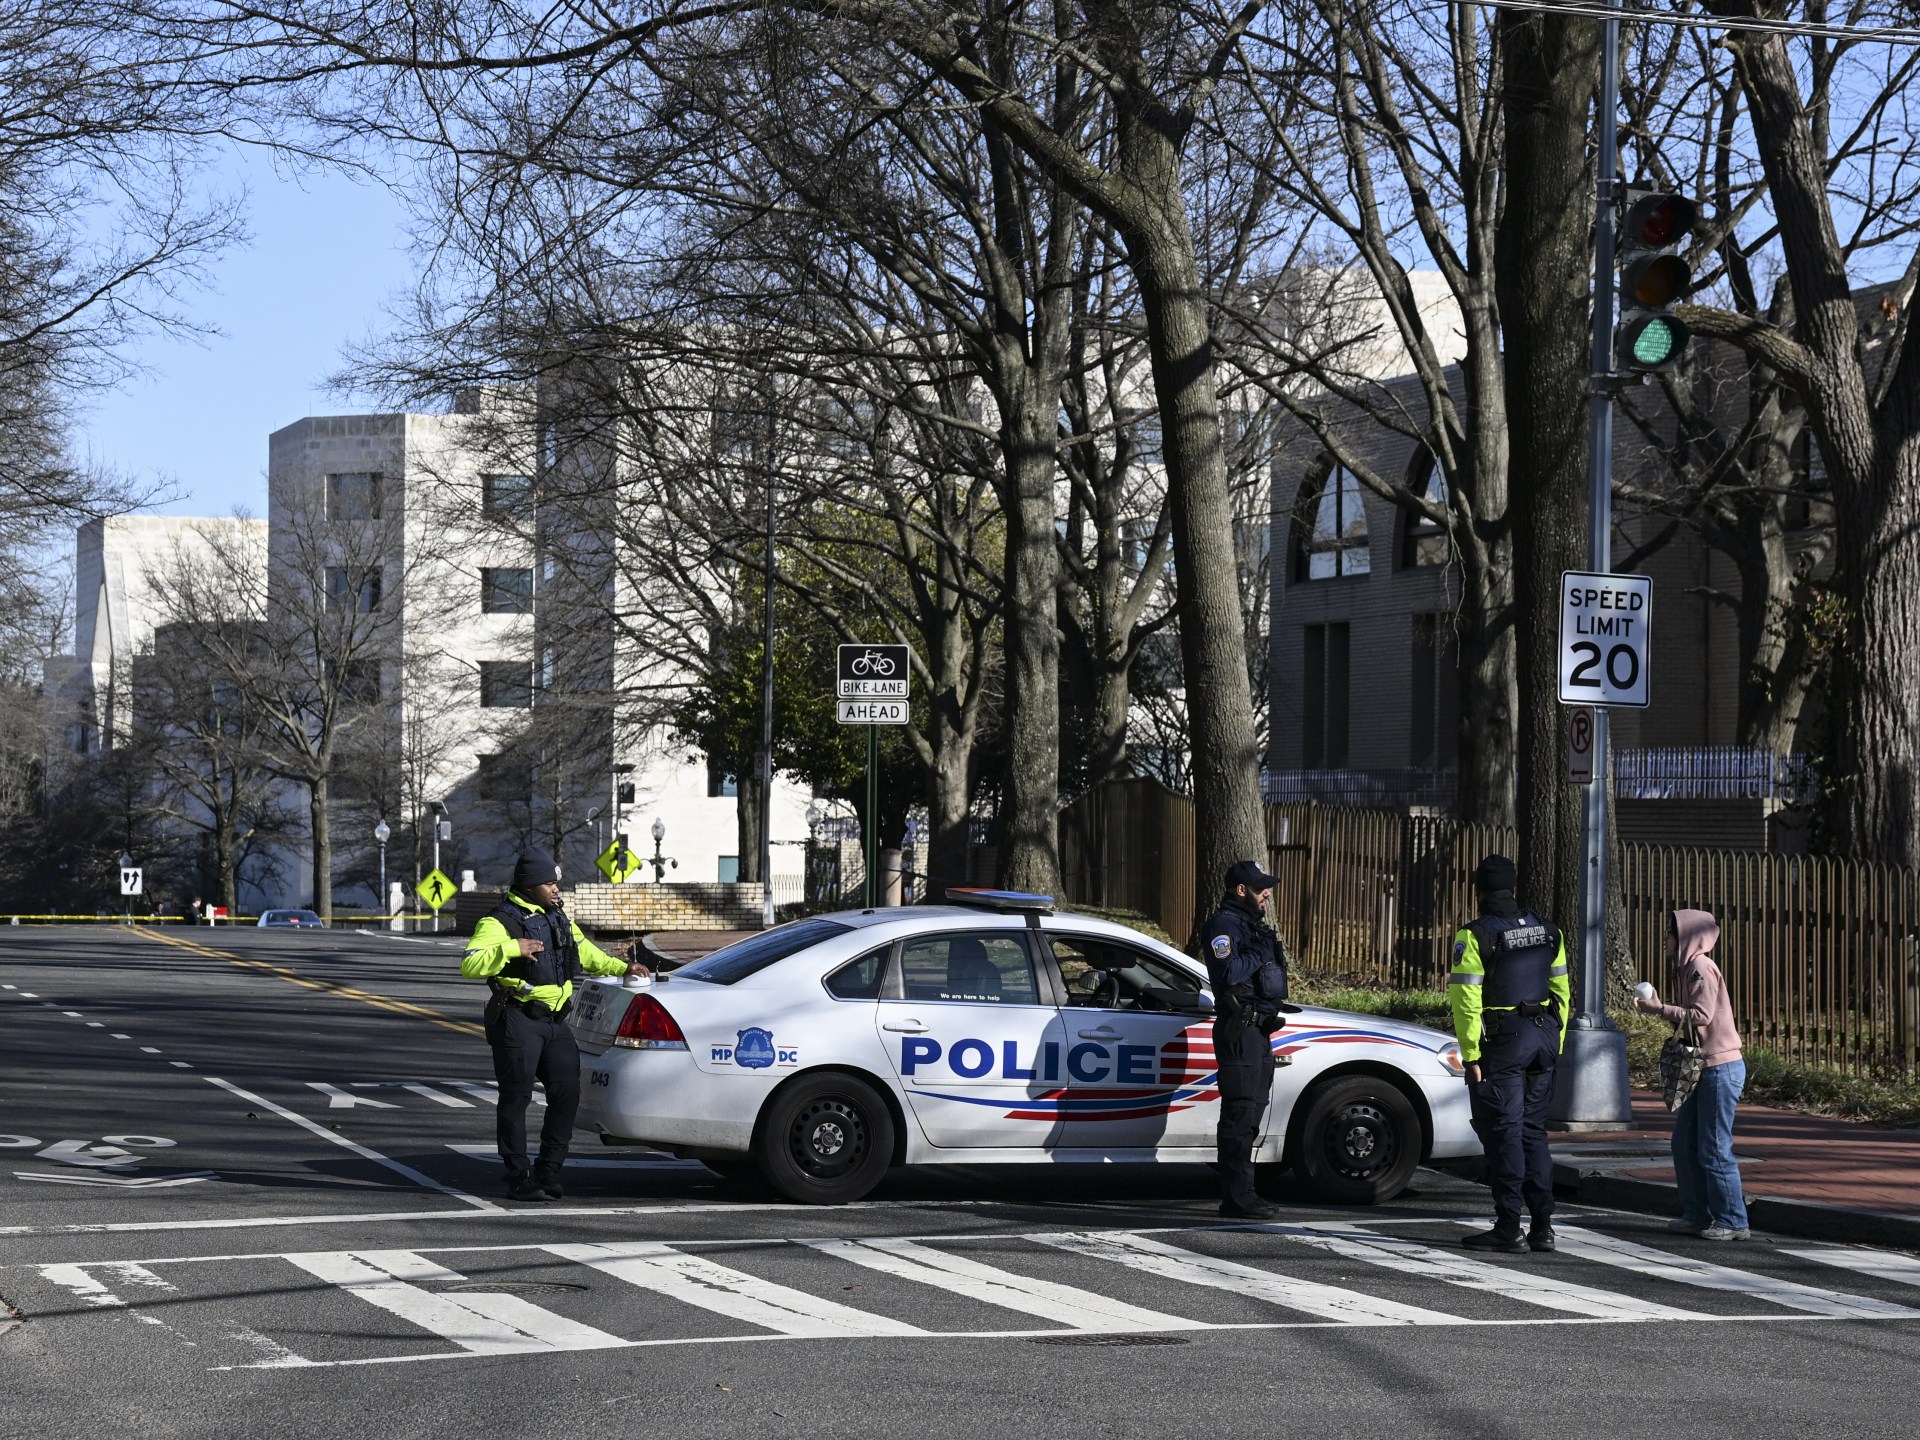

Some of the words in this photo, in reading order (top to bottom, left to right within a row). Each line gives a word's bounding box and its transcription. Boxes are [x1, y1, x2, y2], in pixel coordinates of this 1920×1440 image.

[1569, 588, 1643, 611] SPEED
[1576, 615, 1633, 637] LIMIT
[1569, 641, 1639, 690] 20
[843, 682, 868, 693] BIKE
[874, 682, 903, 693] LANE
[846, 706, 899, 718] AHEAD
[1504, 926, 1546, 939] METROPOLITAN
[1508, 935, 1546, 949] POLICE
[711, 1048, 733, 1060] MP
[778, 1051, 798, 1062] DC
[900, 1036, 1156, 1083] POLICE
[591, 1071, 610, 1087] D43
